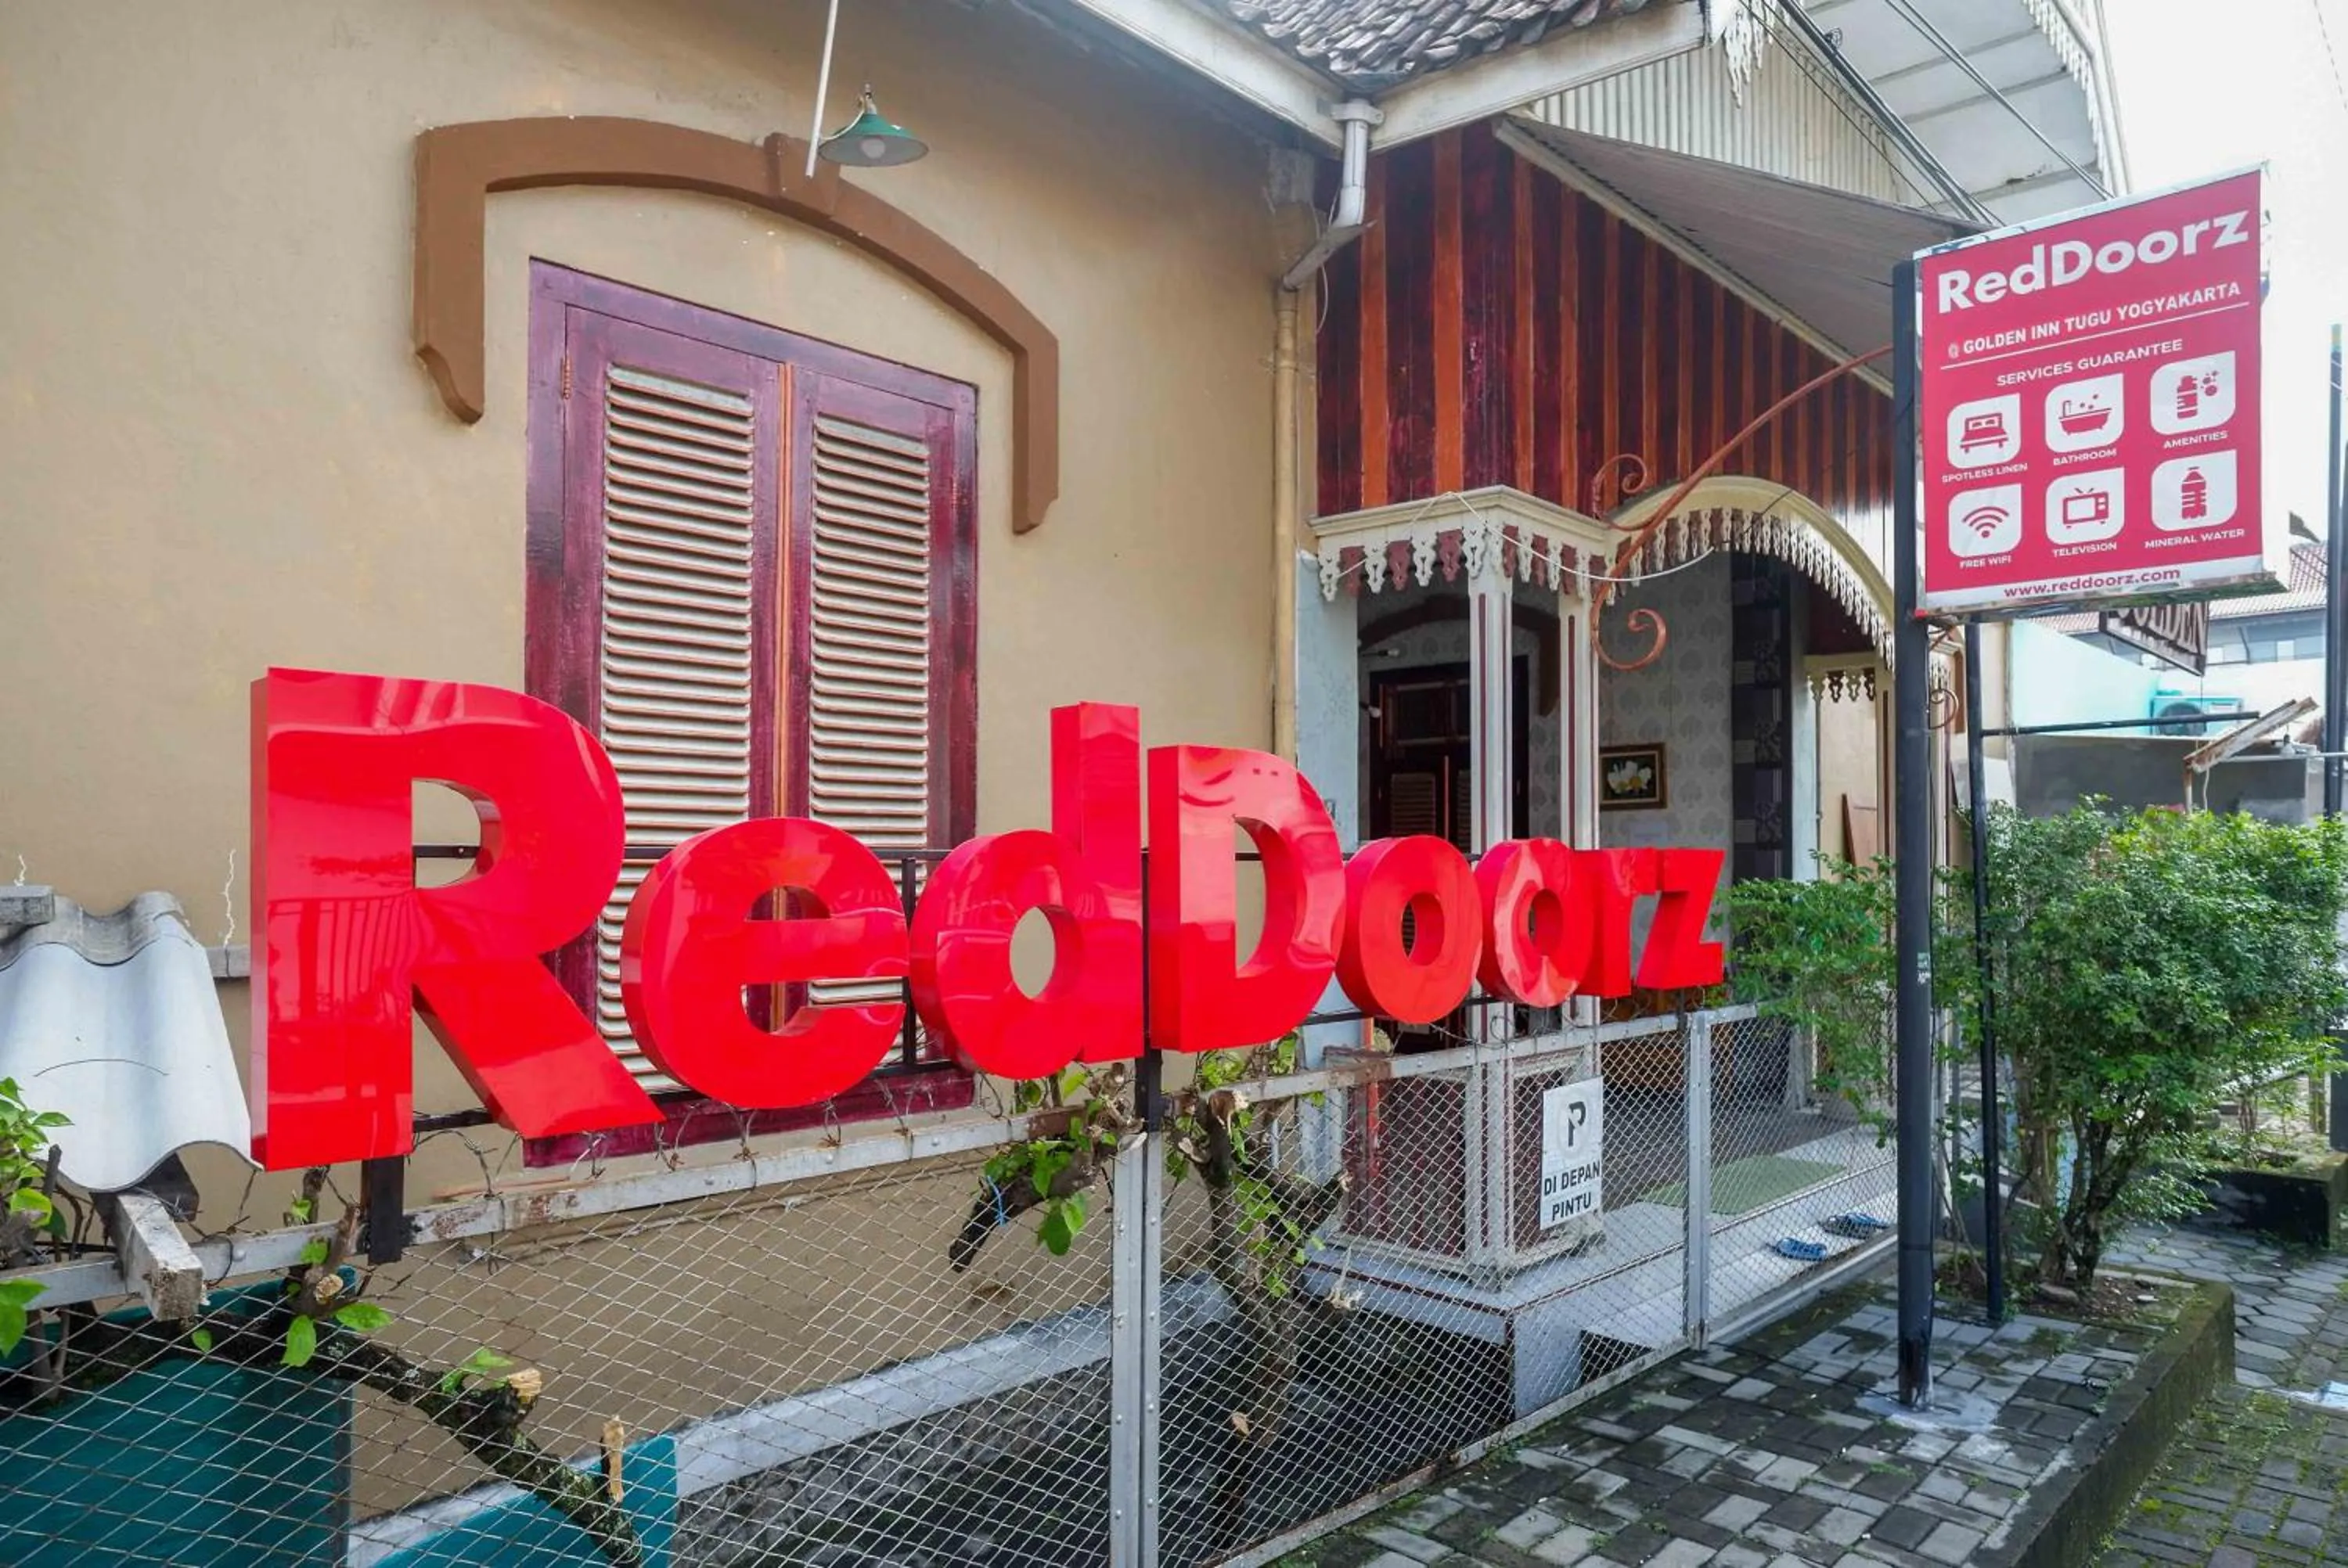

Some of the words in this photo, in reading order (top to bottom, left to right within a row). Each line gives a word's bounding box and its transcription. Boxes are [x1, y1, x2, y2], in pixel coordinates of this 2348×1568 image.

[1938, 210, 2249, 314] RedDoorz
[1963, 329, 2026, 354] GOLDEN
[2031, 319, 2060, 340] INN
[2065, 311, 2112, 333] TUGU
[2116, 282, 2241, 322] YOGYAKARTA
[1997, 363, 2073, 387] SERVICES
[2078, 339, 2183, 371] GUARANTEE
[2163, 430, 2228, 449] AMENITIES
[2053, 448, 2117, 466] BATHROOM
[1942, 467, 1993, 483] SPOTLESS
[1997, 462, 2028, 475] LINEN
[2052, 541, 2117, 558] TELEVISION
[2145, 535, 2197, 549] MINERAL
[2200, 528, 2245, 541] WATER
[1960, 558, 1986, 568] FREE
[1988, 555, 2011, 565] WIFI
[2004, 567, 2181, 597] www.reddoorz.com
[250, 667, 1725, 1171] RedDoorz
[1568, 1101, 1586, 1147] P
[1544, 1176, 1557, 1196] DI
[1561, 1160, 1601, 1190] DEPAN
[1552, 1192, 1592, 1221] PINTU
